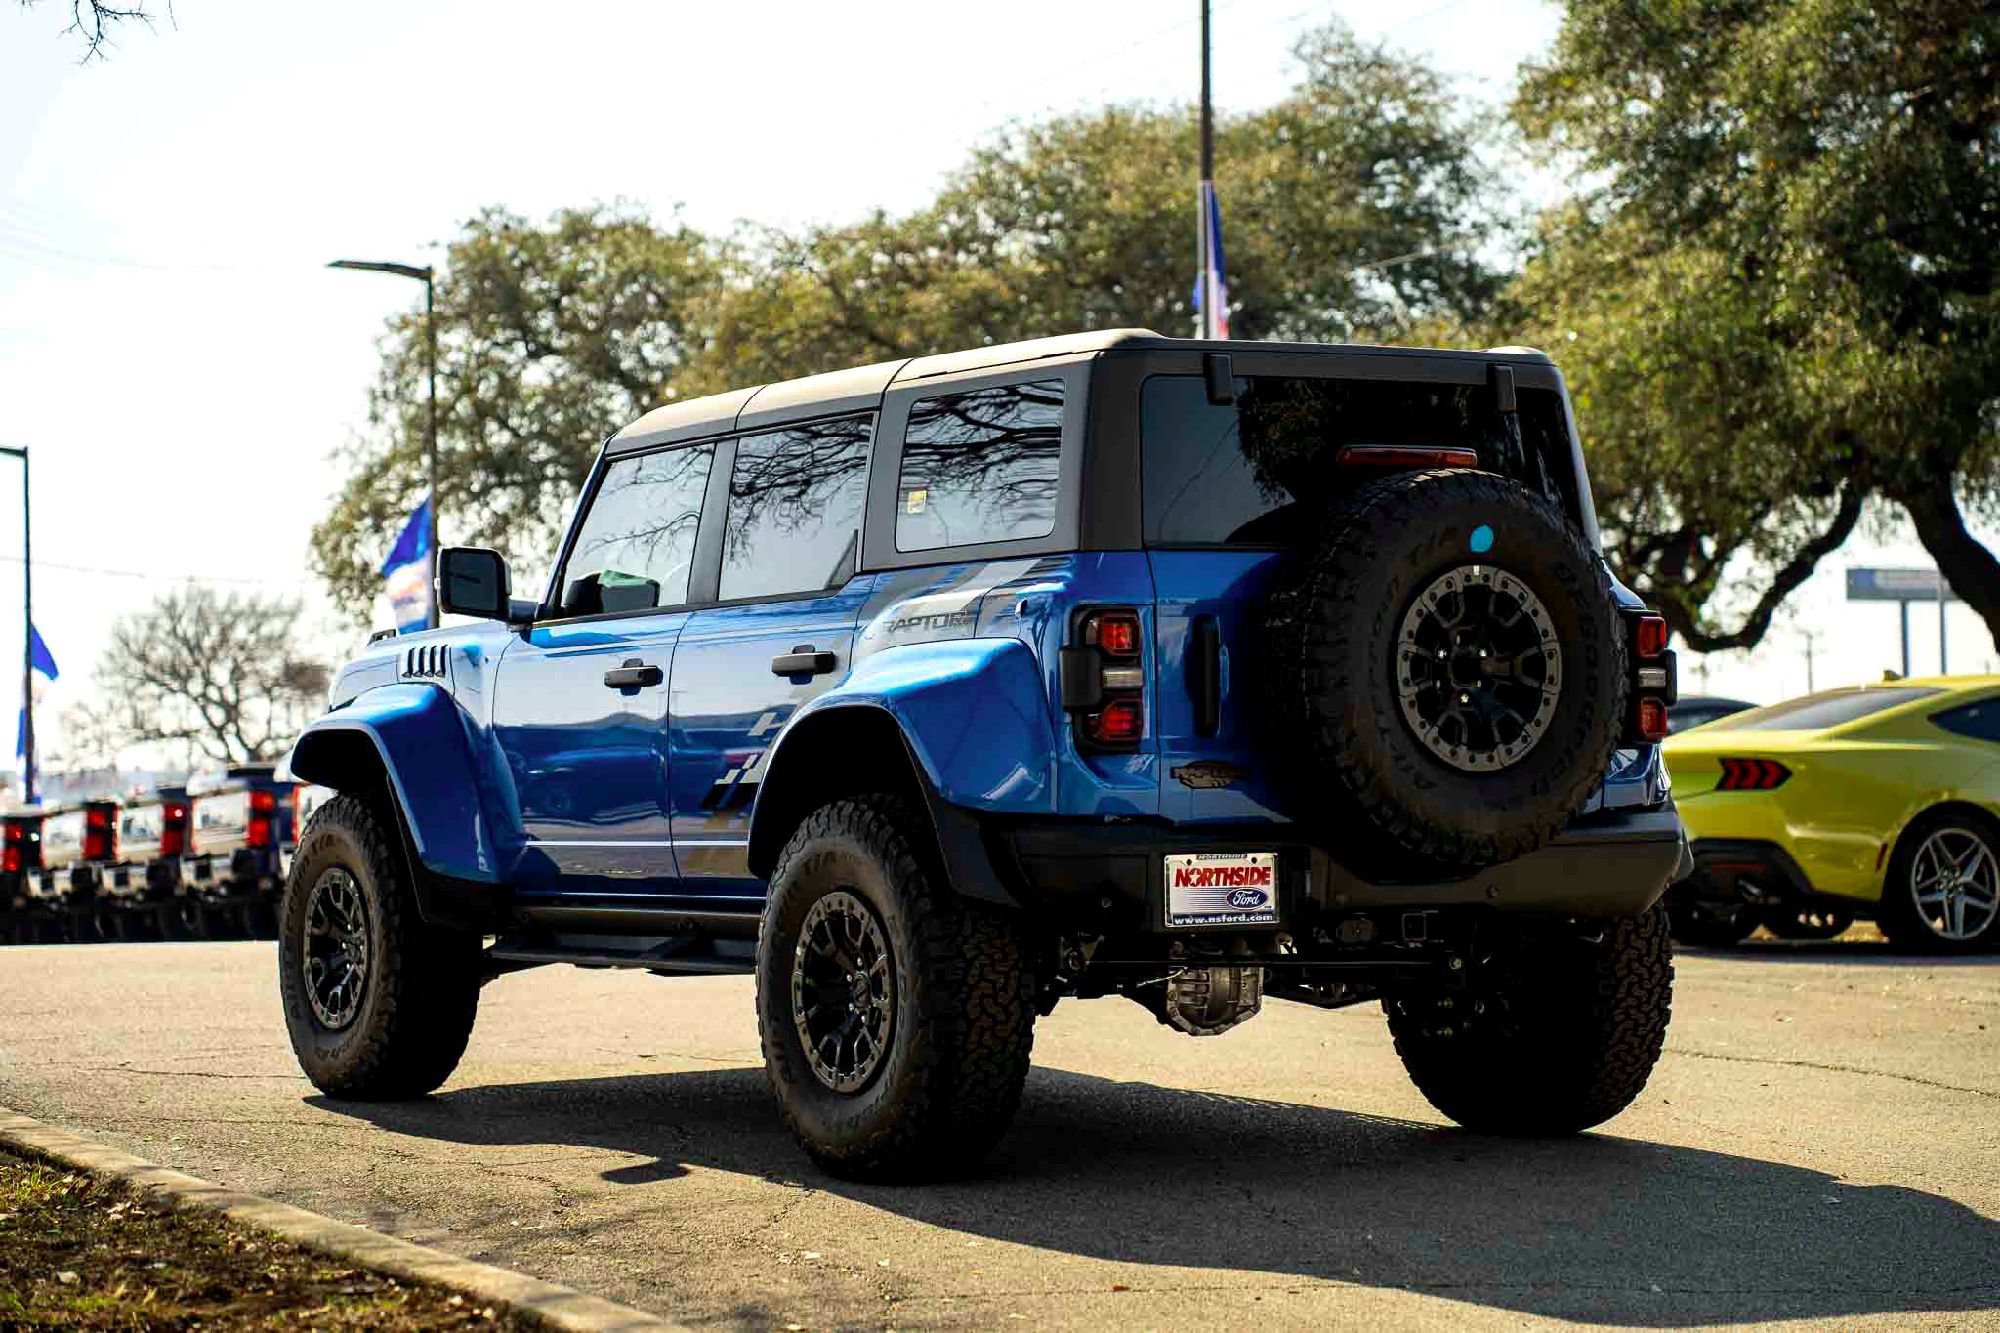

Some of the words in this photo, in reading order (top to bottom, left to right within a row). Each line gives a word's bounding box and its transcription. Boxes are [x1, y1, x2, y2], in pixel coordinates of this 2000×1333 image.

[1175, 867, 1272, 887] NORTHSIDE
[1232, 890, 1260, 905] Ford
[1174, 914, 1273, 925] www.nsford.com
